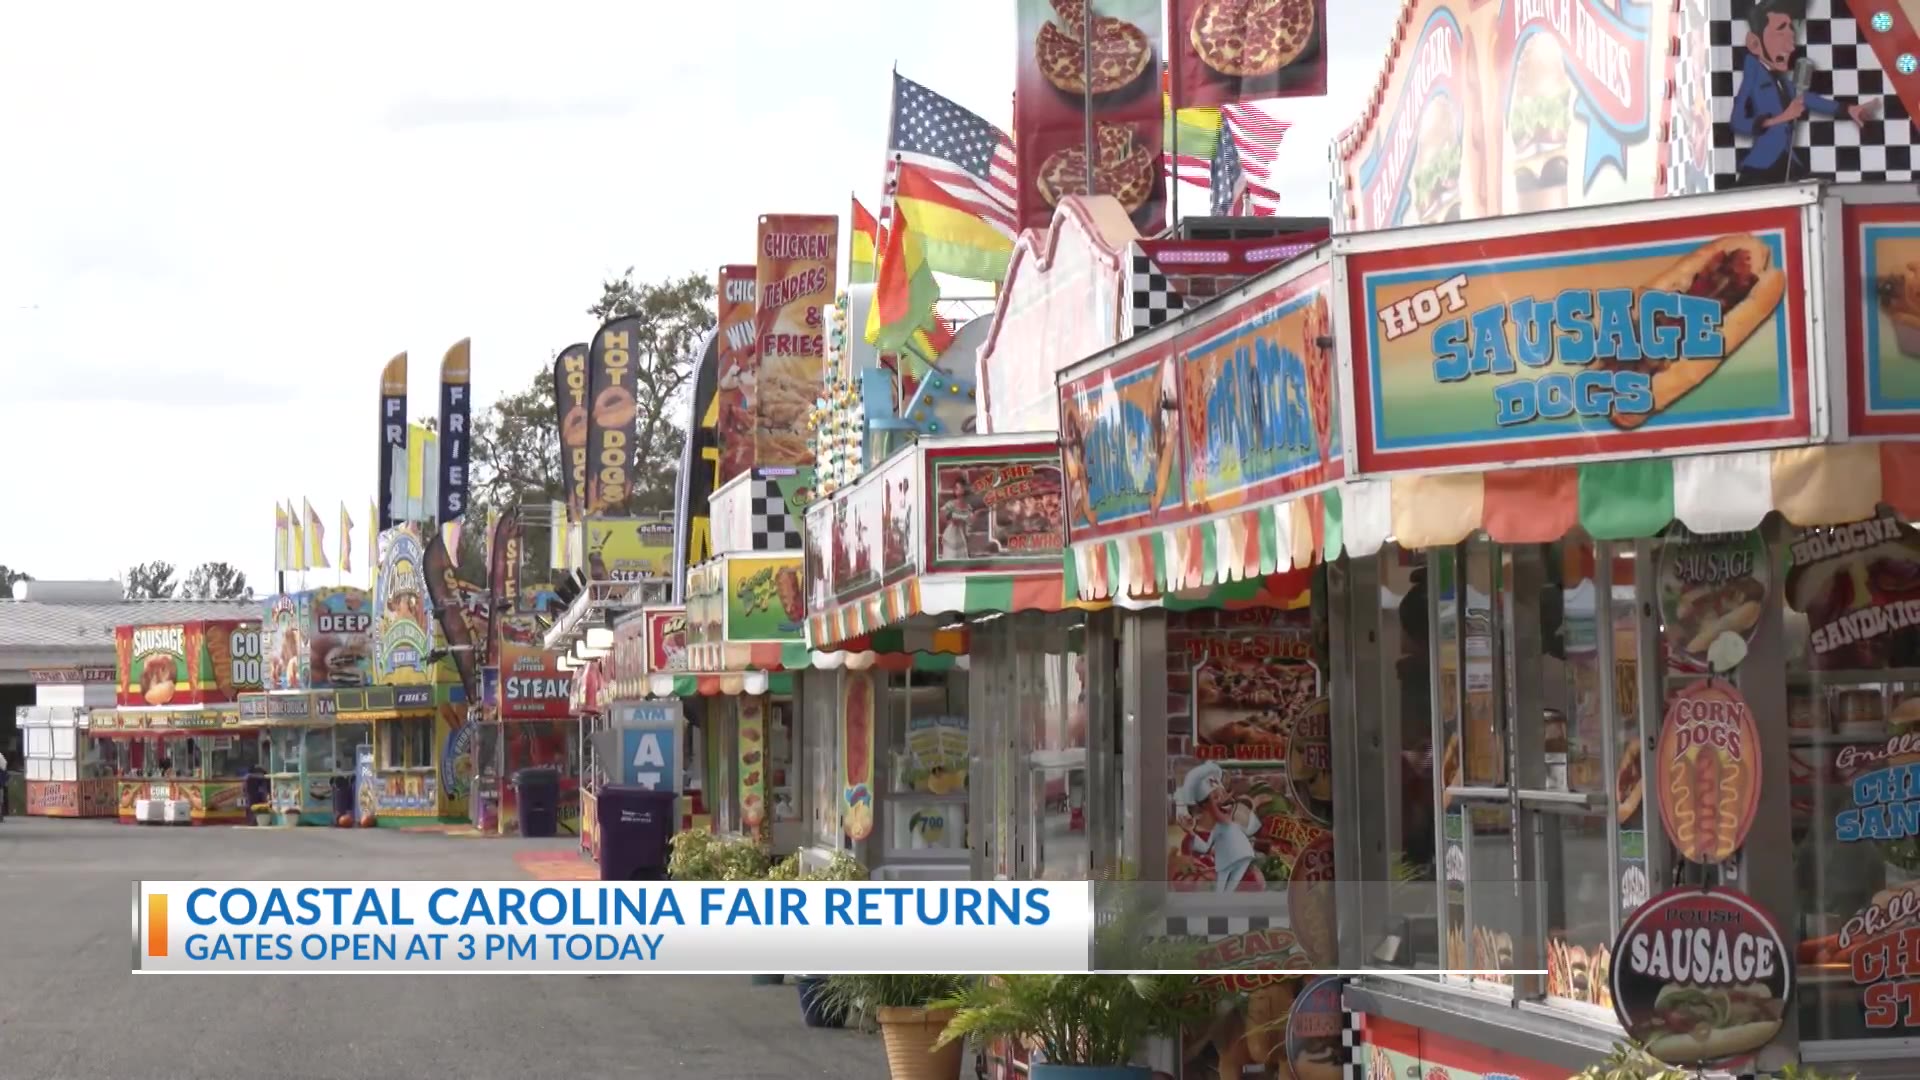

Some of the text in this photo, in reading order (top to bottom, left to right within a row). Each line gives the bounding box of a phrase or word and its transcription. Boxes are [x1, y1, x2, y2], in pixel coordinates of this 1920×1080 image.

[1576, 0, 1632, 109] FRIES
[764, 232, 829, 258] CHICKEN
[764, 266, 827, 309] TENDERS
[1378, 272, 1470, 342] HOT
[805, 306, 822, 329] &
[1431, 288, 1728, 384] SAUSAGE
[604, 330, 631, 386] HOT
[763, 333, 823, 356] FRIES
[564, 354, 585, 406] HOT
[1494, 370, 1656, 428] DOGS
[448, 386, 465, 512] FRIES
[601, 429, 628, 503] DOGS
[1788, 518, 1901, 568] BOLOGNA
[133, 626, 184, 656] SAUSAGE
[319, 613, 370, 633] DEEP
[506, 676, 570, 699] STEAK
[1674, 698, 1745, 731] CORN
[1673, 722, 1742, 762] DOGS
[1664, 908, 1744, 923] POLISH
[1630, 927, 1775, 984] SAUSAGE
